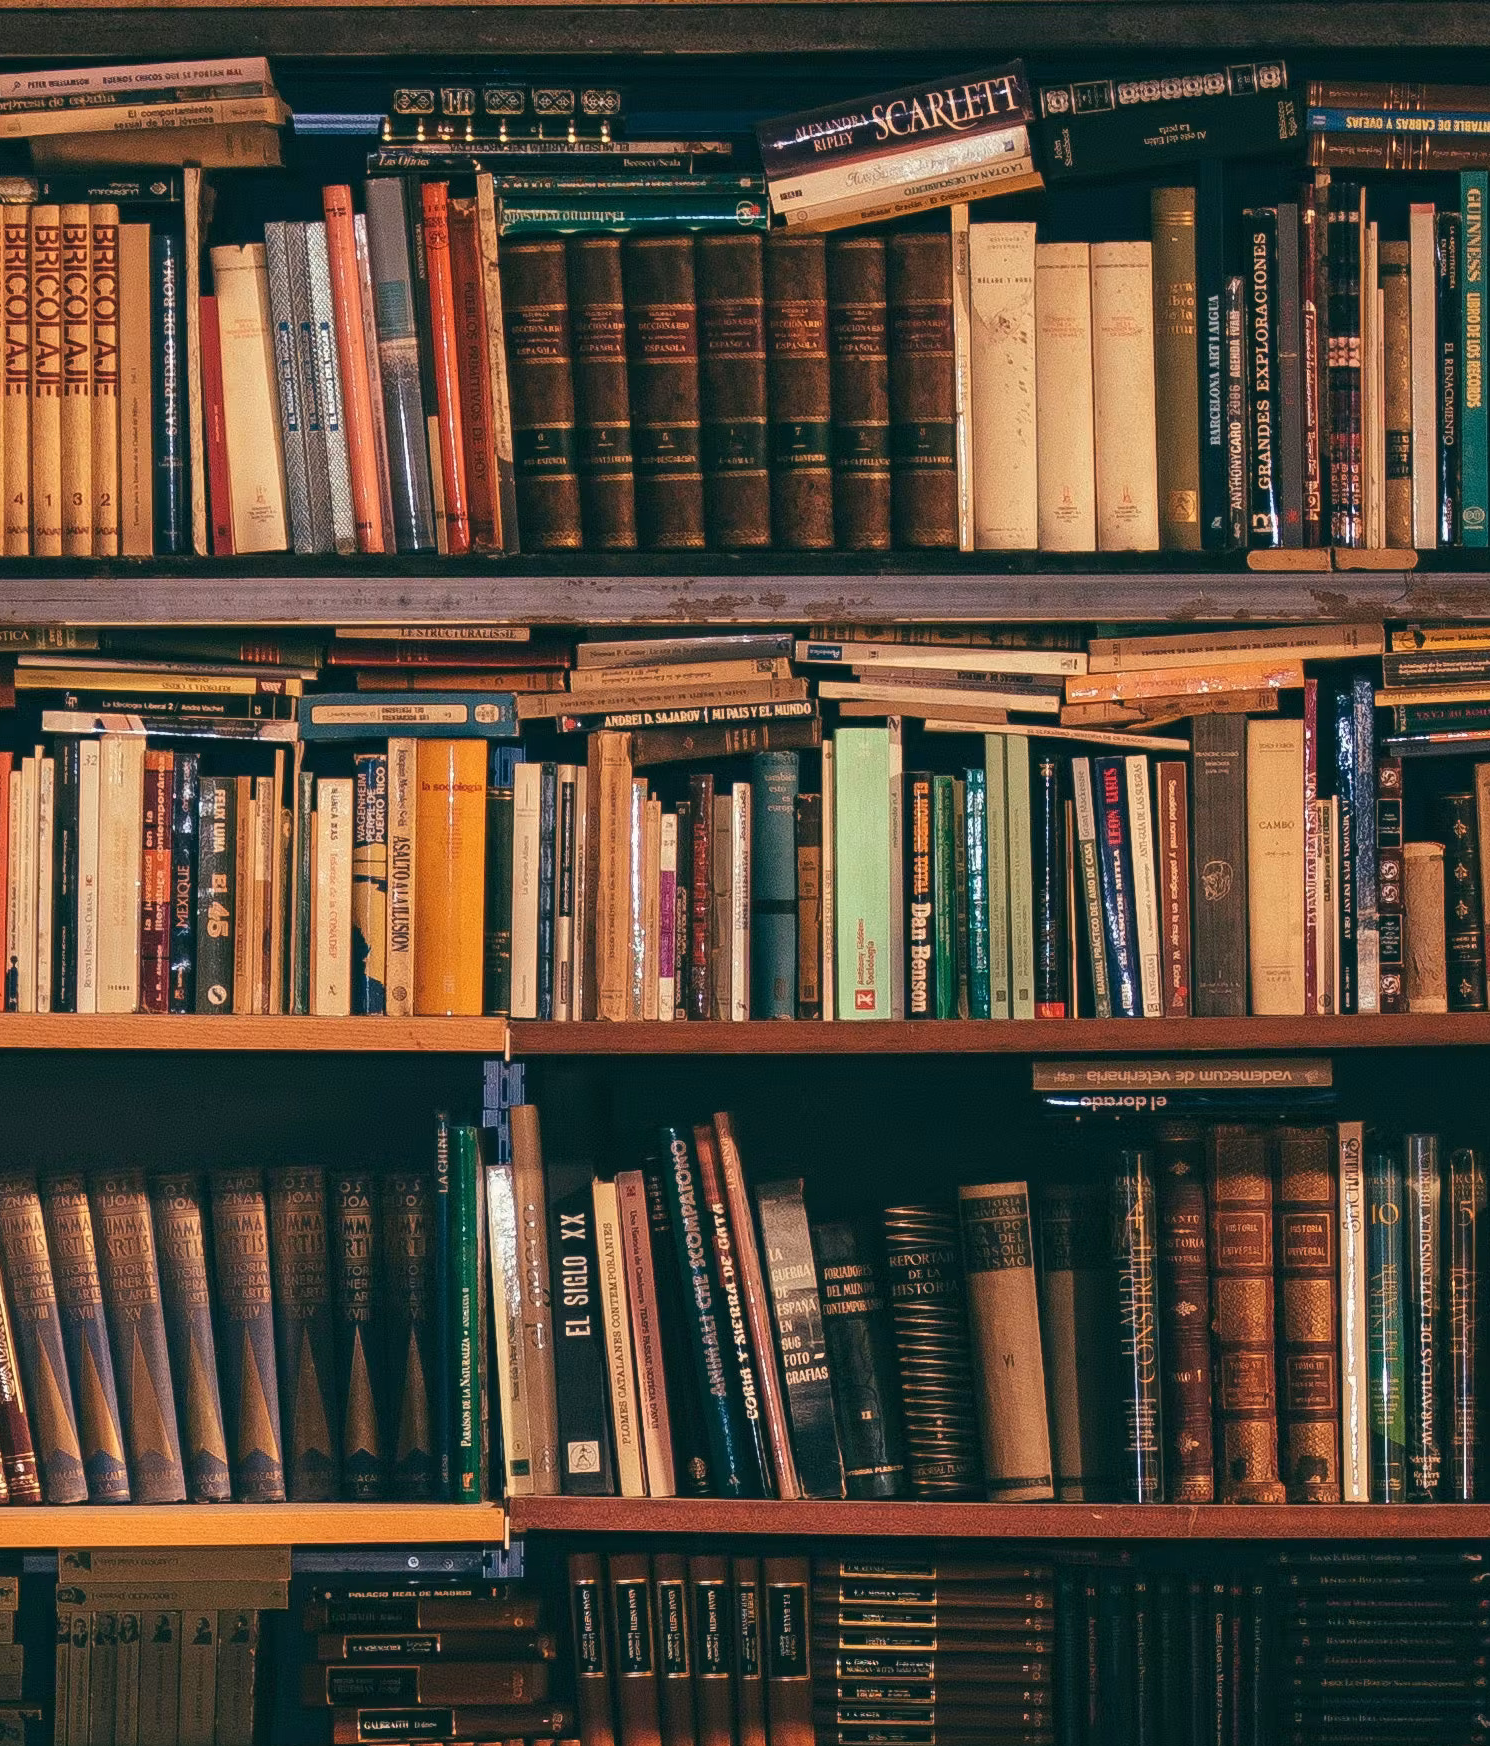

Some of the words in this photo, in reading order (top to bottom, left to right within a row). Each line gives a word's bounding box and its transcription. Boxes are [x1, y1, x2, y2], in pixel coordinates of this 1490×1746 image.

[871, 76, 1019, 139] SCARLETT
[795, 114, 866, 139] ALEXANDRA
[812, 131, 851, 152] RIPLEY
[1466, 188, 1482, 282] GUINNESS
[65, 224, 88, 397] BRICOLAJE
[1253, 232, 1269, 391] EXPLORACIONES
[1466, 292, 1481, 323] LIBRO
[1466, 325, 1481, 337] DE
[1443, 342, 1454, 355] EL
[1466, 338, 1481, 360] LOS
[1443, 358, 1454, 446] RENACIMIENTO
[1257, 400, 1271, 490] GRANDES
[605, 716, 642, 728] ANDREI
[656, 710, 700, 723] SAJAROV
[712, 709, 722, 719] MI
[751, 706, 758, 717] Y
[759, 706, 771, 717] EL
[774, 703, 812, 716] MUNDO
[213, 823, 225, 853] LUNA
[176, 863, 191, 927] MEXIQUE
[208, 901, 228, 937] 45
[911, 902, 931, 940] Dan
[911, 945, 931, 1012] Benson
[1086, 1070, 1171, 1084] veterinaria
[1176, 1070, 1194, 1084] de
[1199, 1070, 1291, 1084] vademecum
[1080, 1096, 1147, 1112] dorado
[1151, 1096, 1167, 1111] el
[670, 1140, 702, 1266] SCOMPAIONO
[559, 1213, 585, 1240] XX
[563, 1255, 589, 1306] SIGLO
[771, 1265, 810, 1281] GUERRA
[691, 1272, 711, 1306] CHE
[566, 1316, 592, 1336] EL
[698, 1312, 727, 1399] ANIMALI
